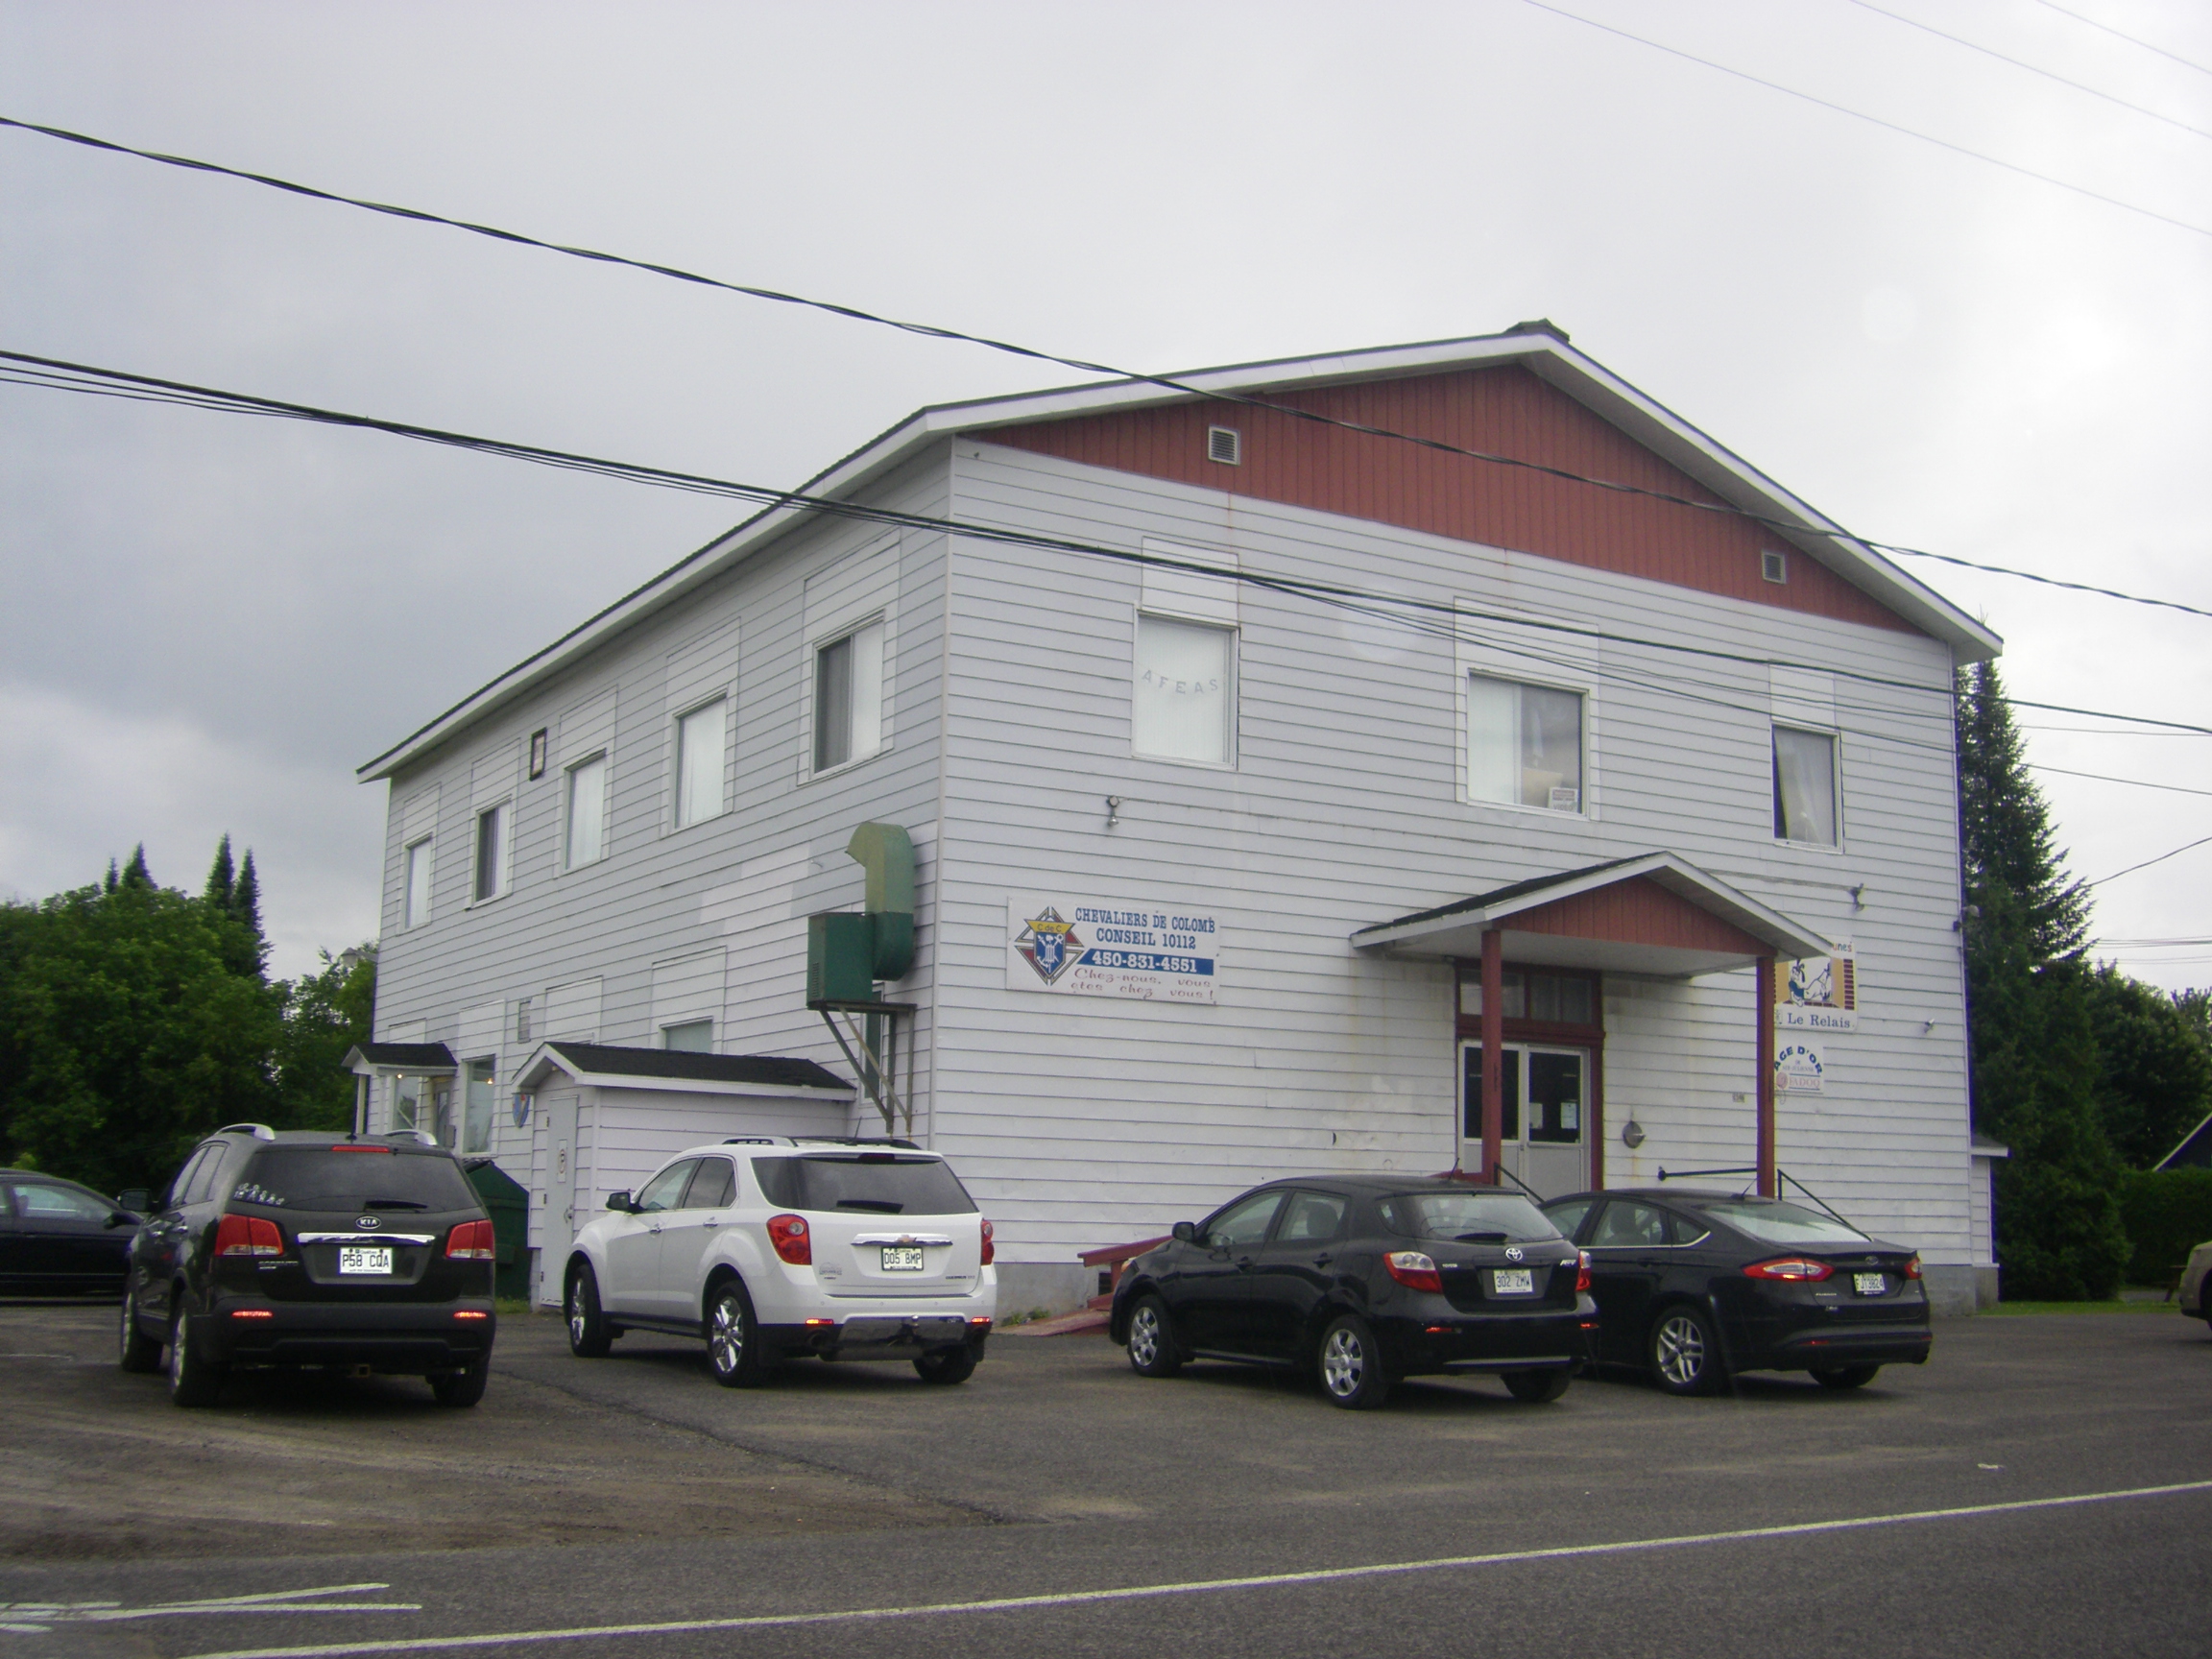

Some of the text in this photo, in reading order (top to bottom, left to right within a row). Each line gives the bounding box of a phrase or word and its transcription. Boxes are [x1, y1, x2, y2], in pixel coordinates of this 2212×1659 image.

[1142, 669, 1218, 694] AFEAS
[1075, 907, 1215, 934] CHEVALIERS DE COLOMB
[1096, 927, 1196, 950] CONSEIL 10112
[1832, 943, 1853, 952] unes
[1092, 950, 1197, 973] 450-831-4551
[1177, 978, 1212, 988] vous
[1119, 983, 1154, 1000] chez
[1788, 1013, 1851, 1028] Le Relais
[1797, 1046, 1822, 1074] D'OR
[1789, 1076, 1820, 1088] FADOQ
[342, 1254, 389, 1268] P58 CQA
[905, 1253, 921, 1264] BMP
[1496, 1276, 1511, 1287] 302
